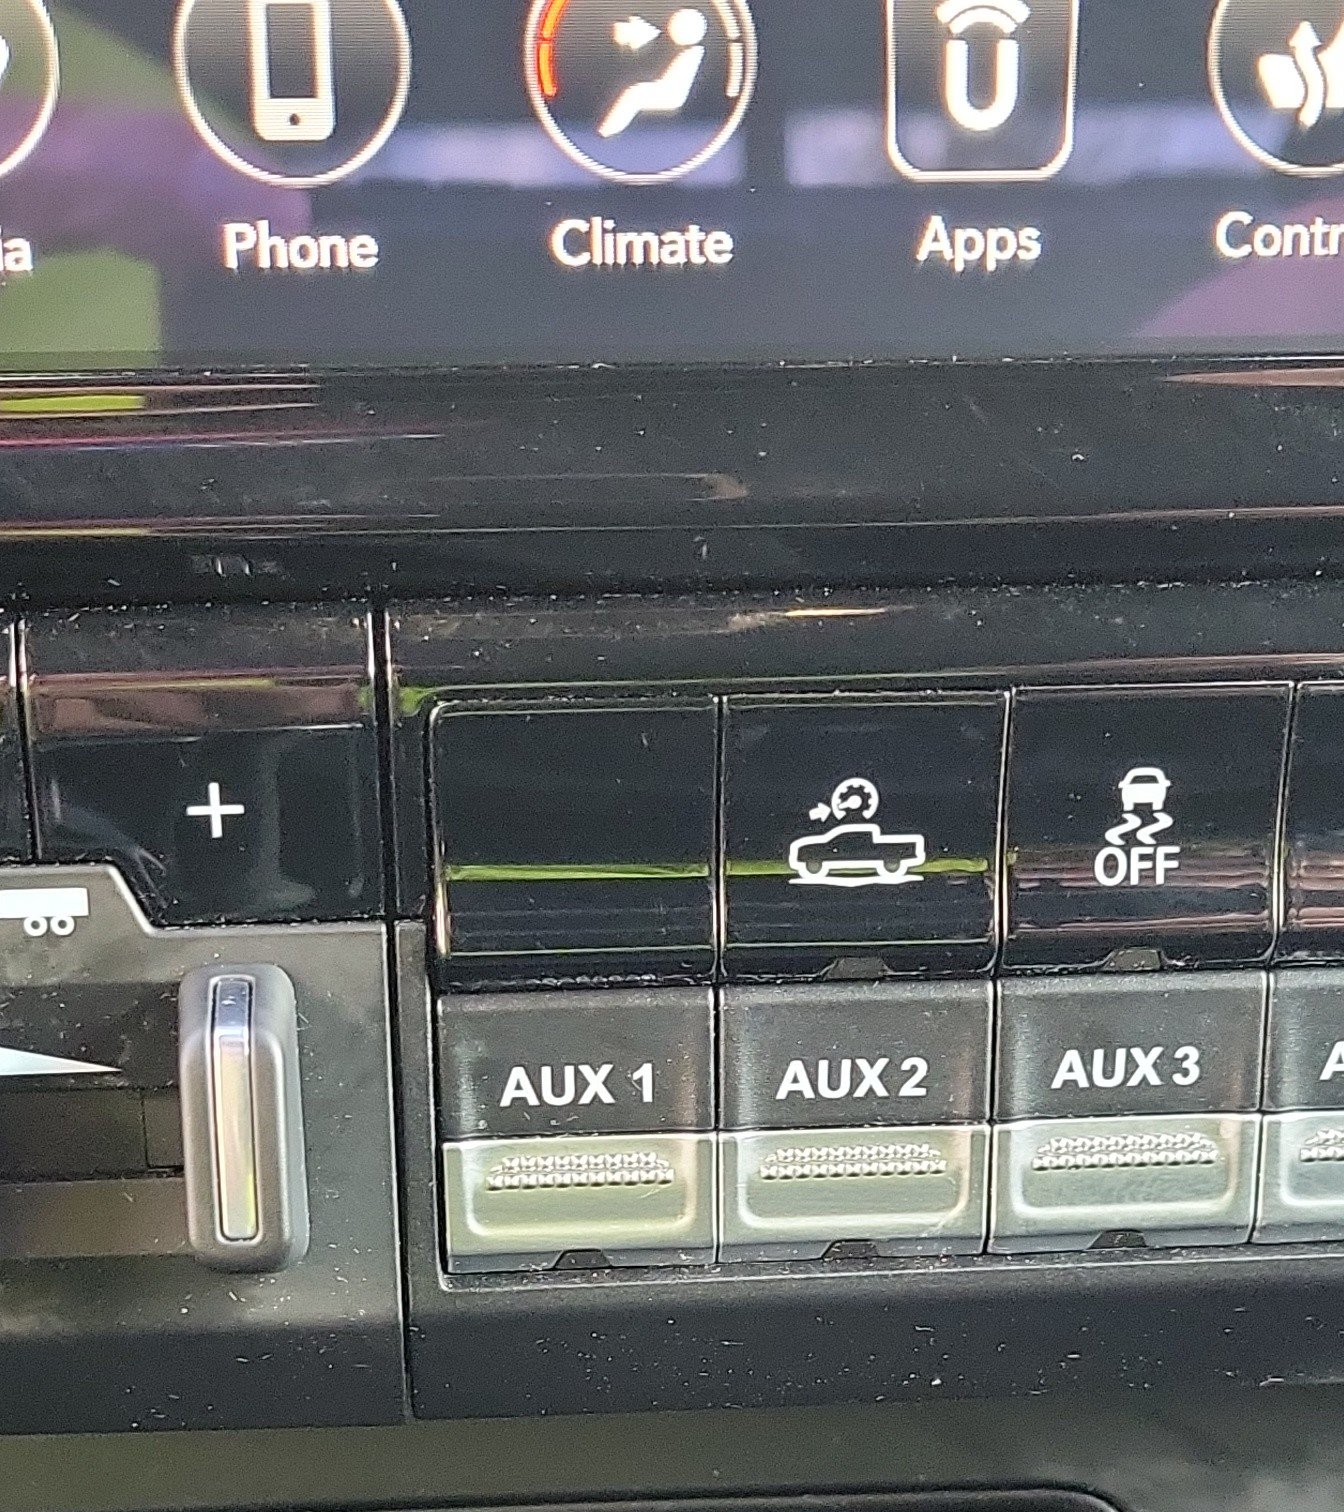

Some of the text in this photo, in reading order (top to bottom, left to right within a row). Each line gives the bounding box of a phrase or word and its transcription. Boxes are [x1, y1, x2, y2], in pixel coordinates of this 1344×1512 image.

[223, 220, 379, 270] Phone
[551, 217, 734, 267] Climate
[916, 216, 1042, 272] Apps
[1093, 846, 1180, 887] OFF
[499, 1063, 654, 1107] AUX 1
[776, 1057, 928, 1100] AUX 2
[1050, 1046, 1201, 1089] AUX 3
